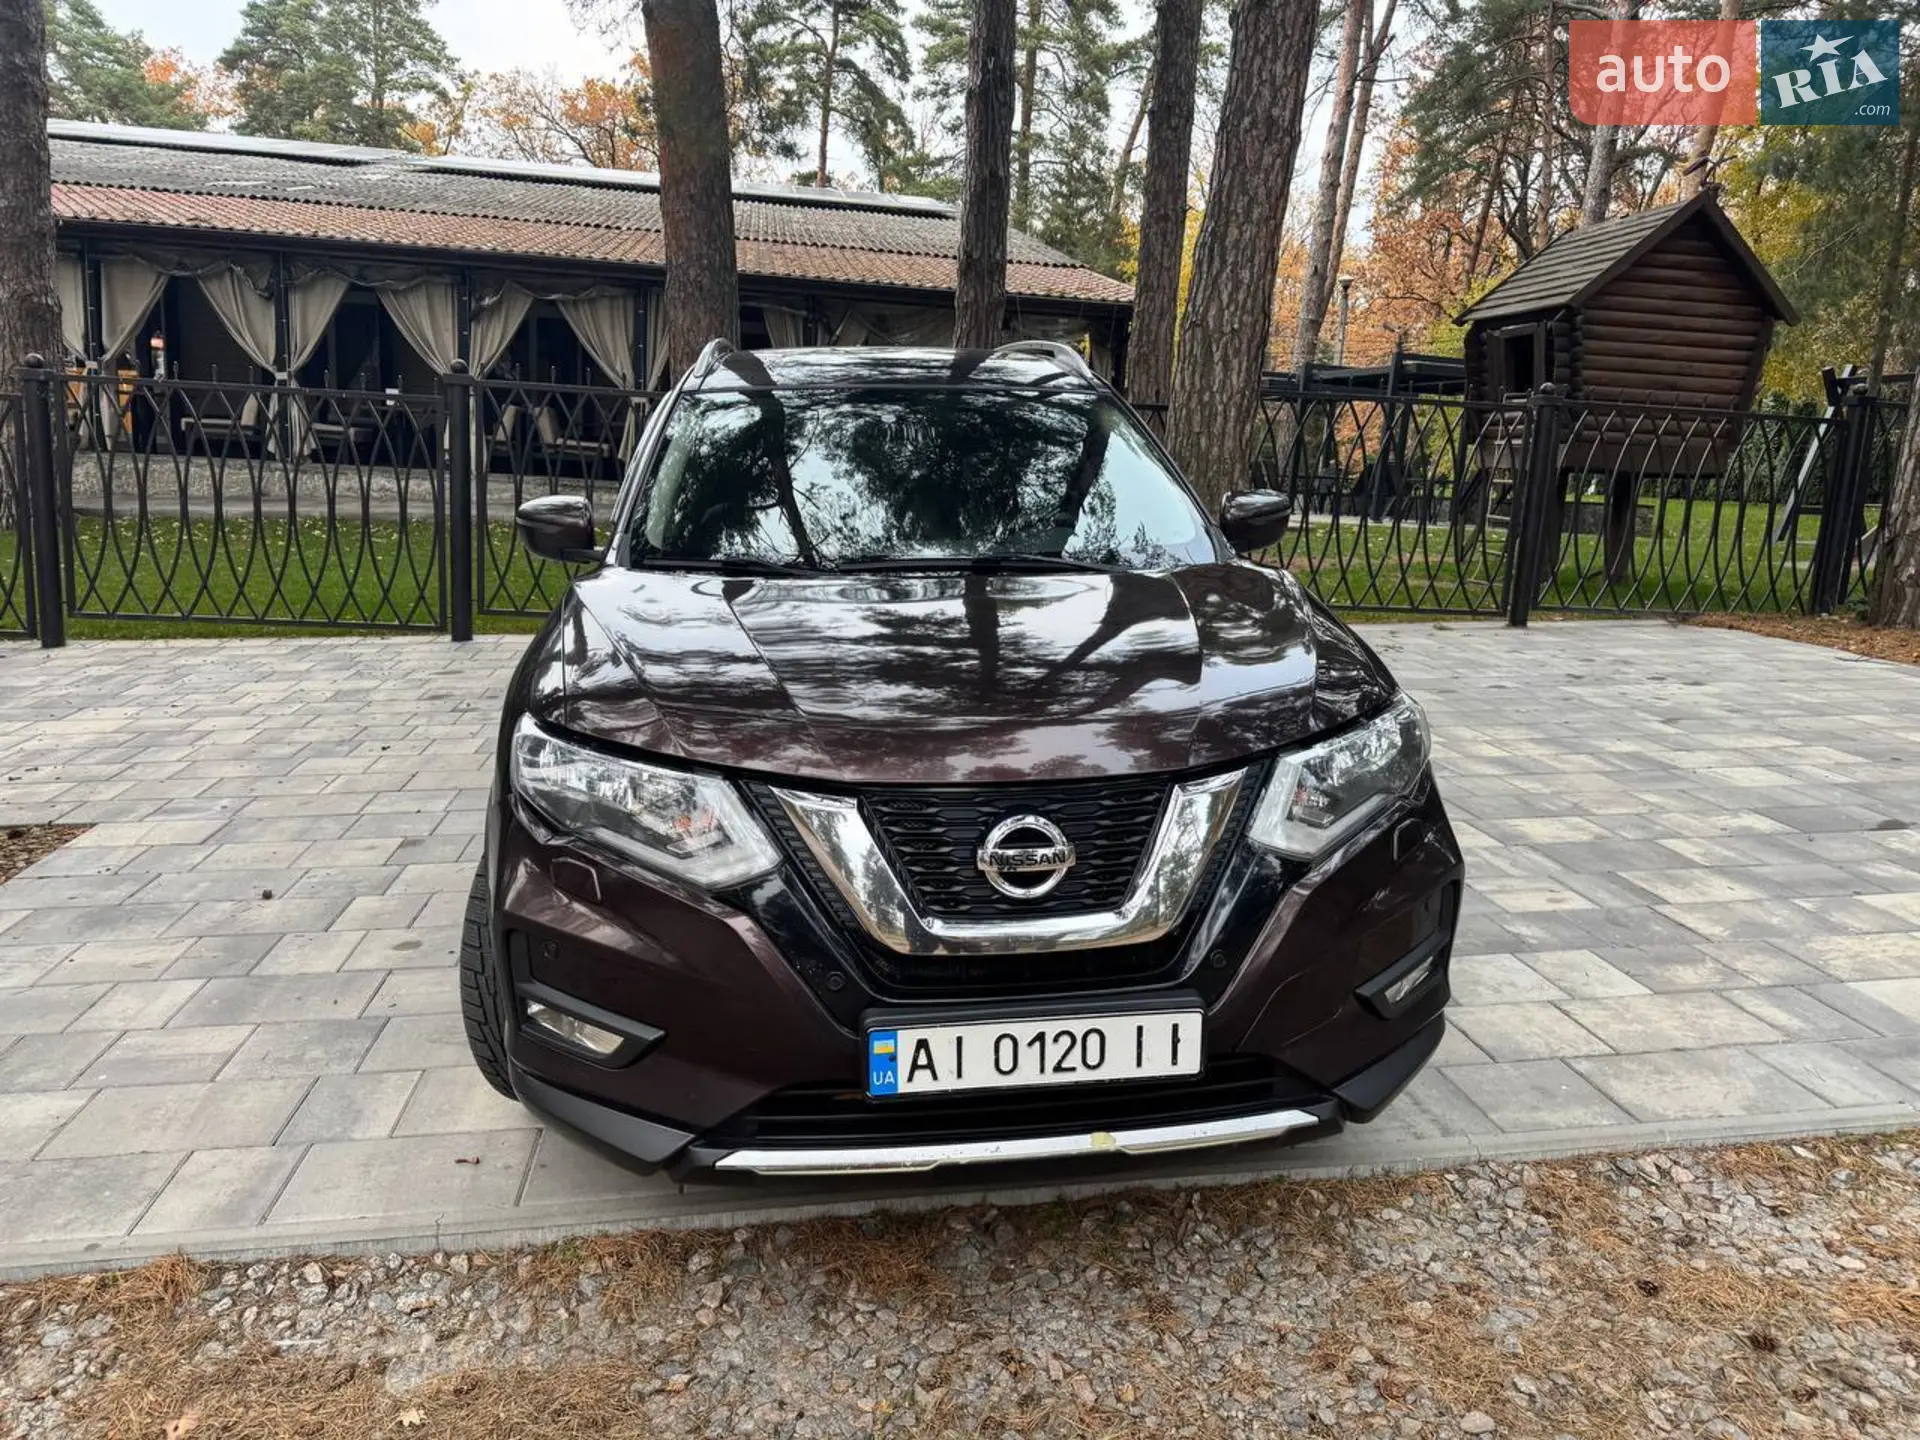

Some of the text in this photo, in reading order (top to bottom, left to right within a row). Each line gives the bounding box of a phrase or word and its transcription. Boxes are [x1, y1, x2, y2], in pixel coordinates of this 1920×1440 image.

[989, 851, 1066, 867] NISSAN
[907, 1023, 1181, 1083] AI 0120 II
[873, 1070, 895, 1085] UA
